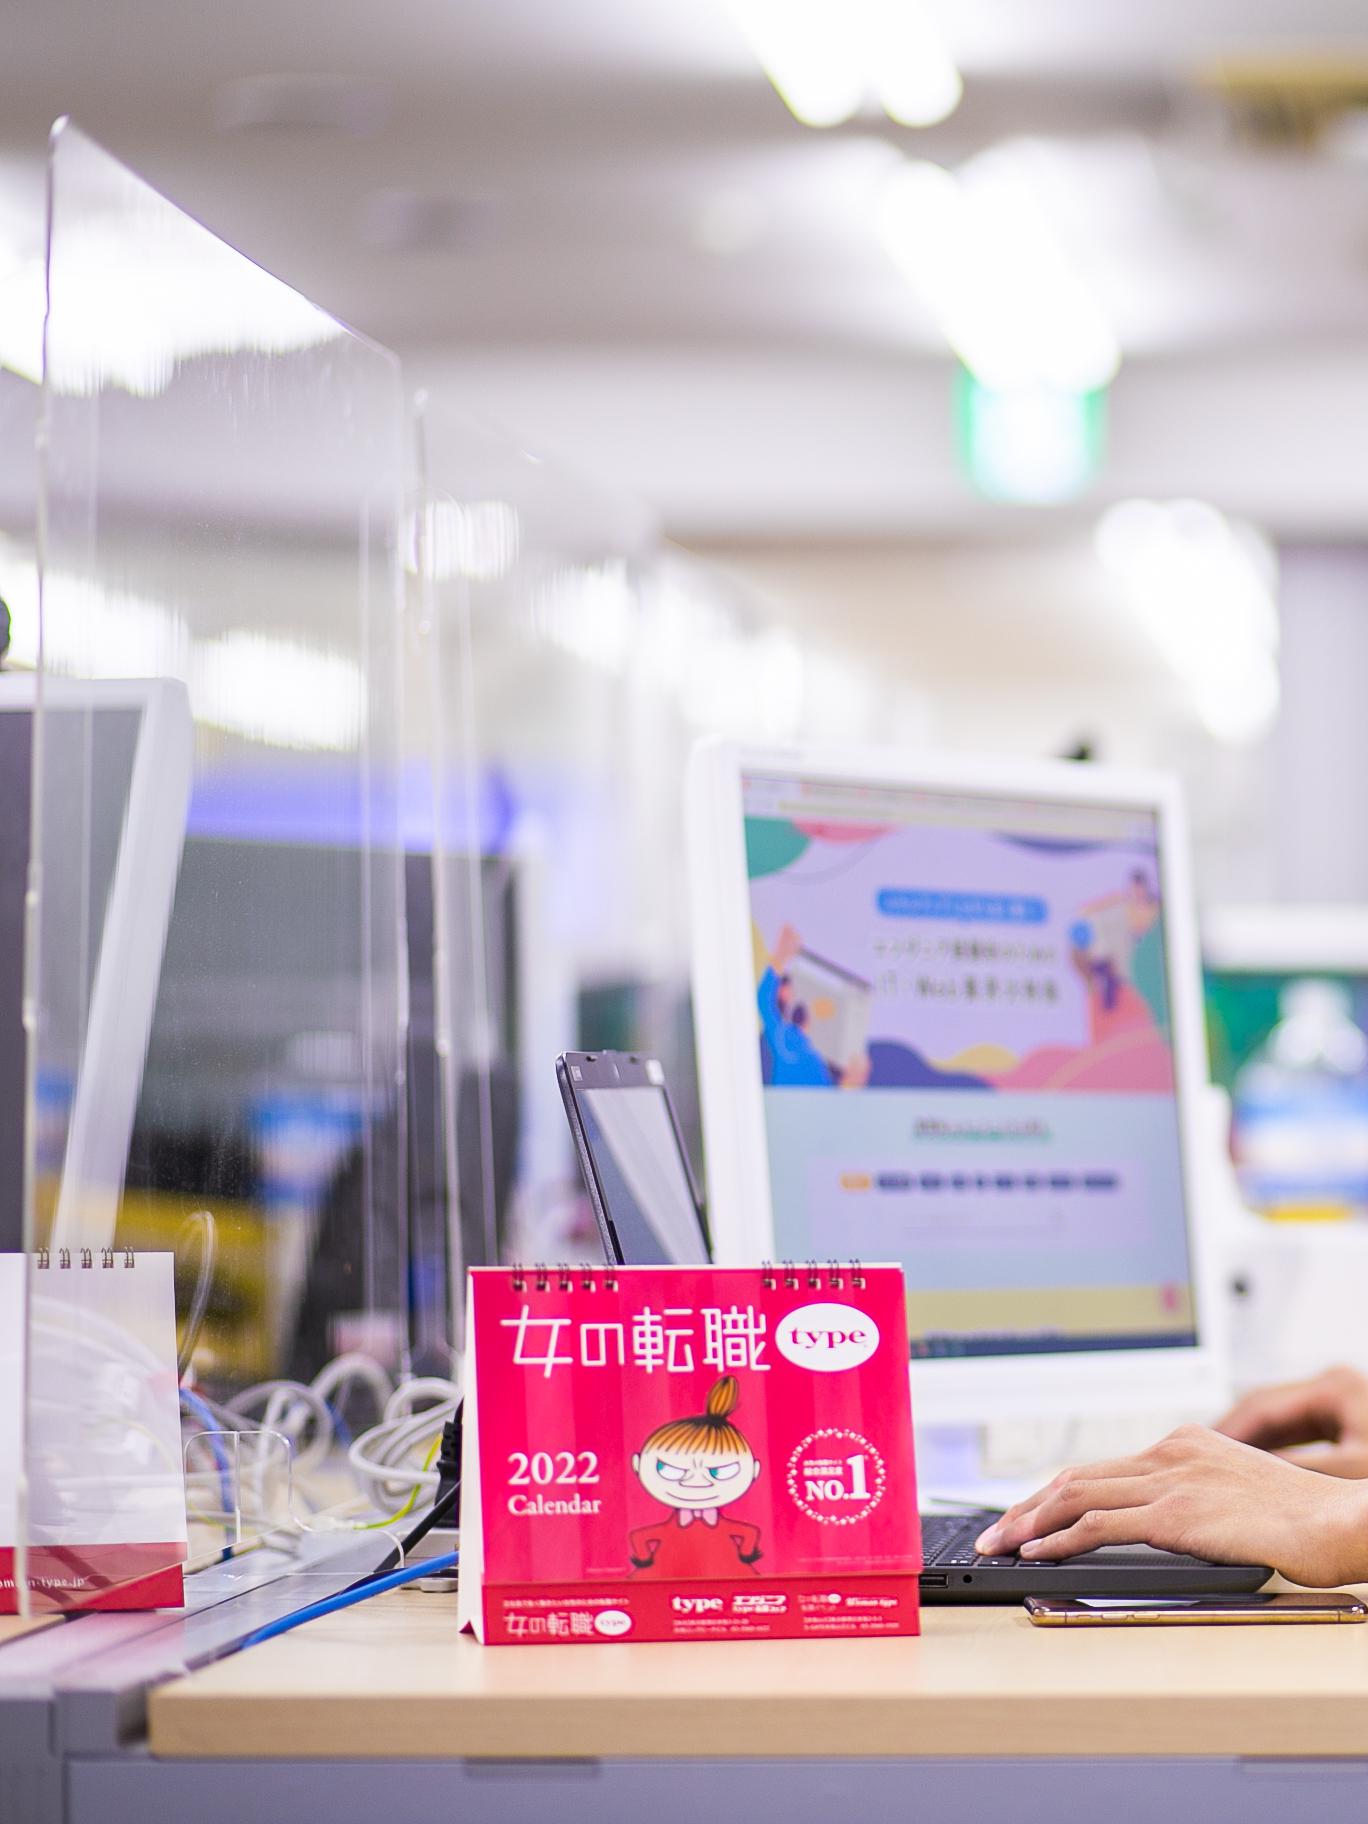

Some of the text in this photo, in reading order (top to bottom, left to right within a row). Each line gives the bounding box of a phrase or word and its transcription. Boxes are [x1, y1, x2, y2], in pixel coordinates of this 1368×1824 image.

[500, 1304, 867, 1379] 女の転職 type
[508, 1451, 600, 1485] 2022
[804, 1454, 871, 1501] NO.1
[507, 1493, 602, 1517] Calendar
[671, 1596, 723, 1613] type
[503, 1611, 594, 1637] 女の転職
